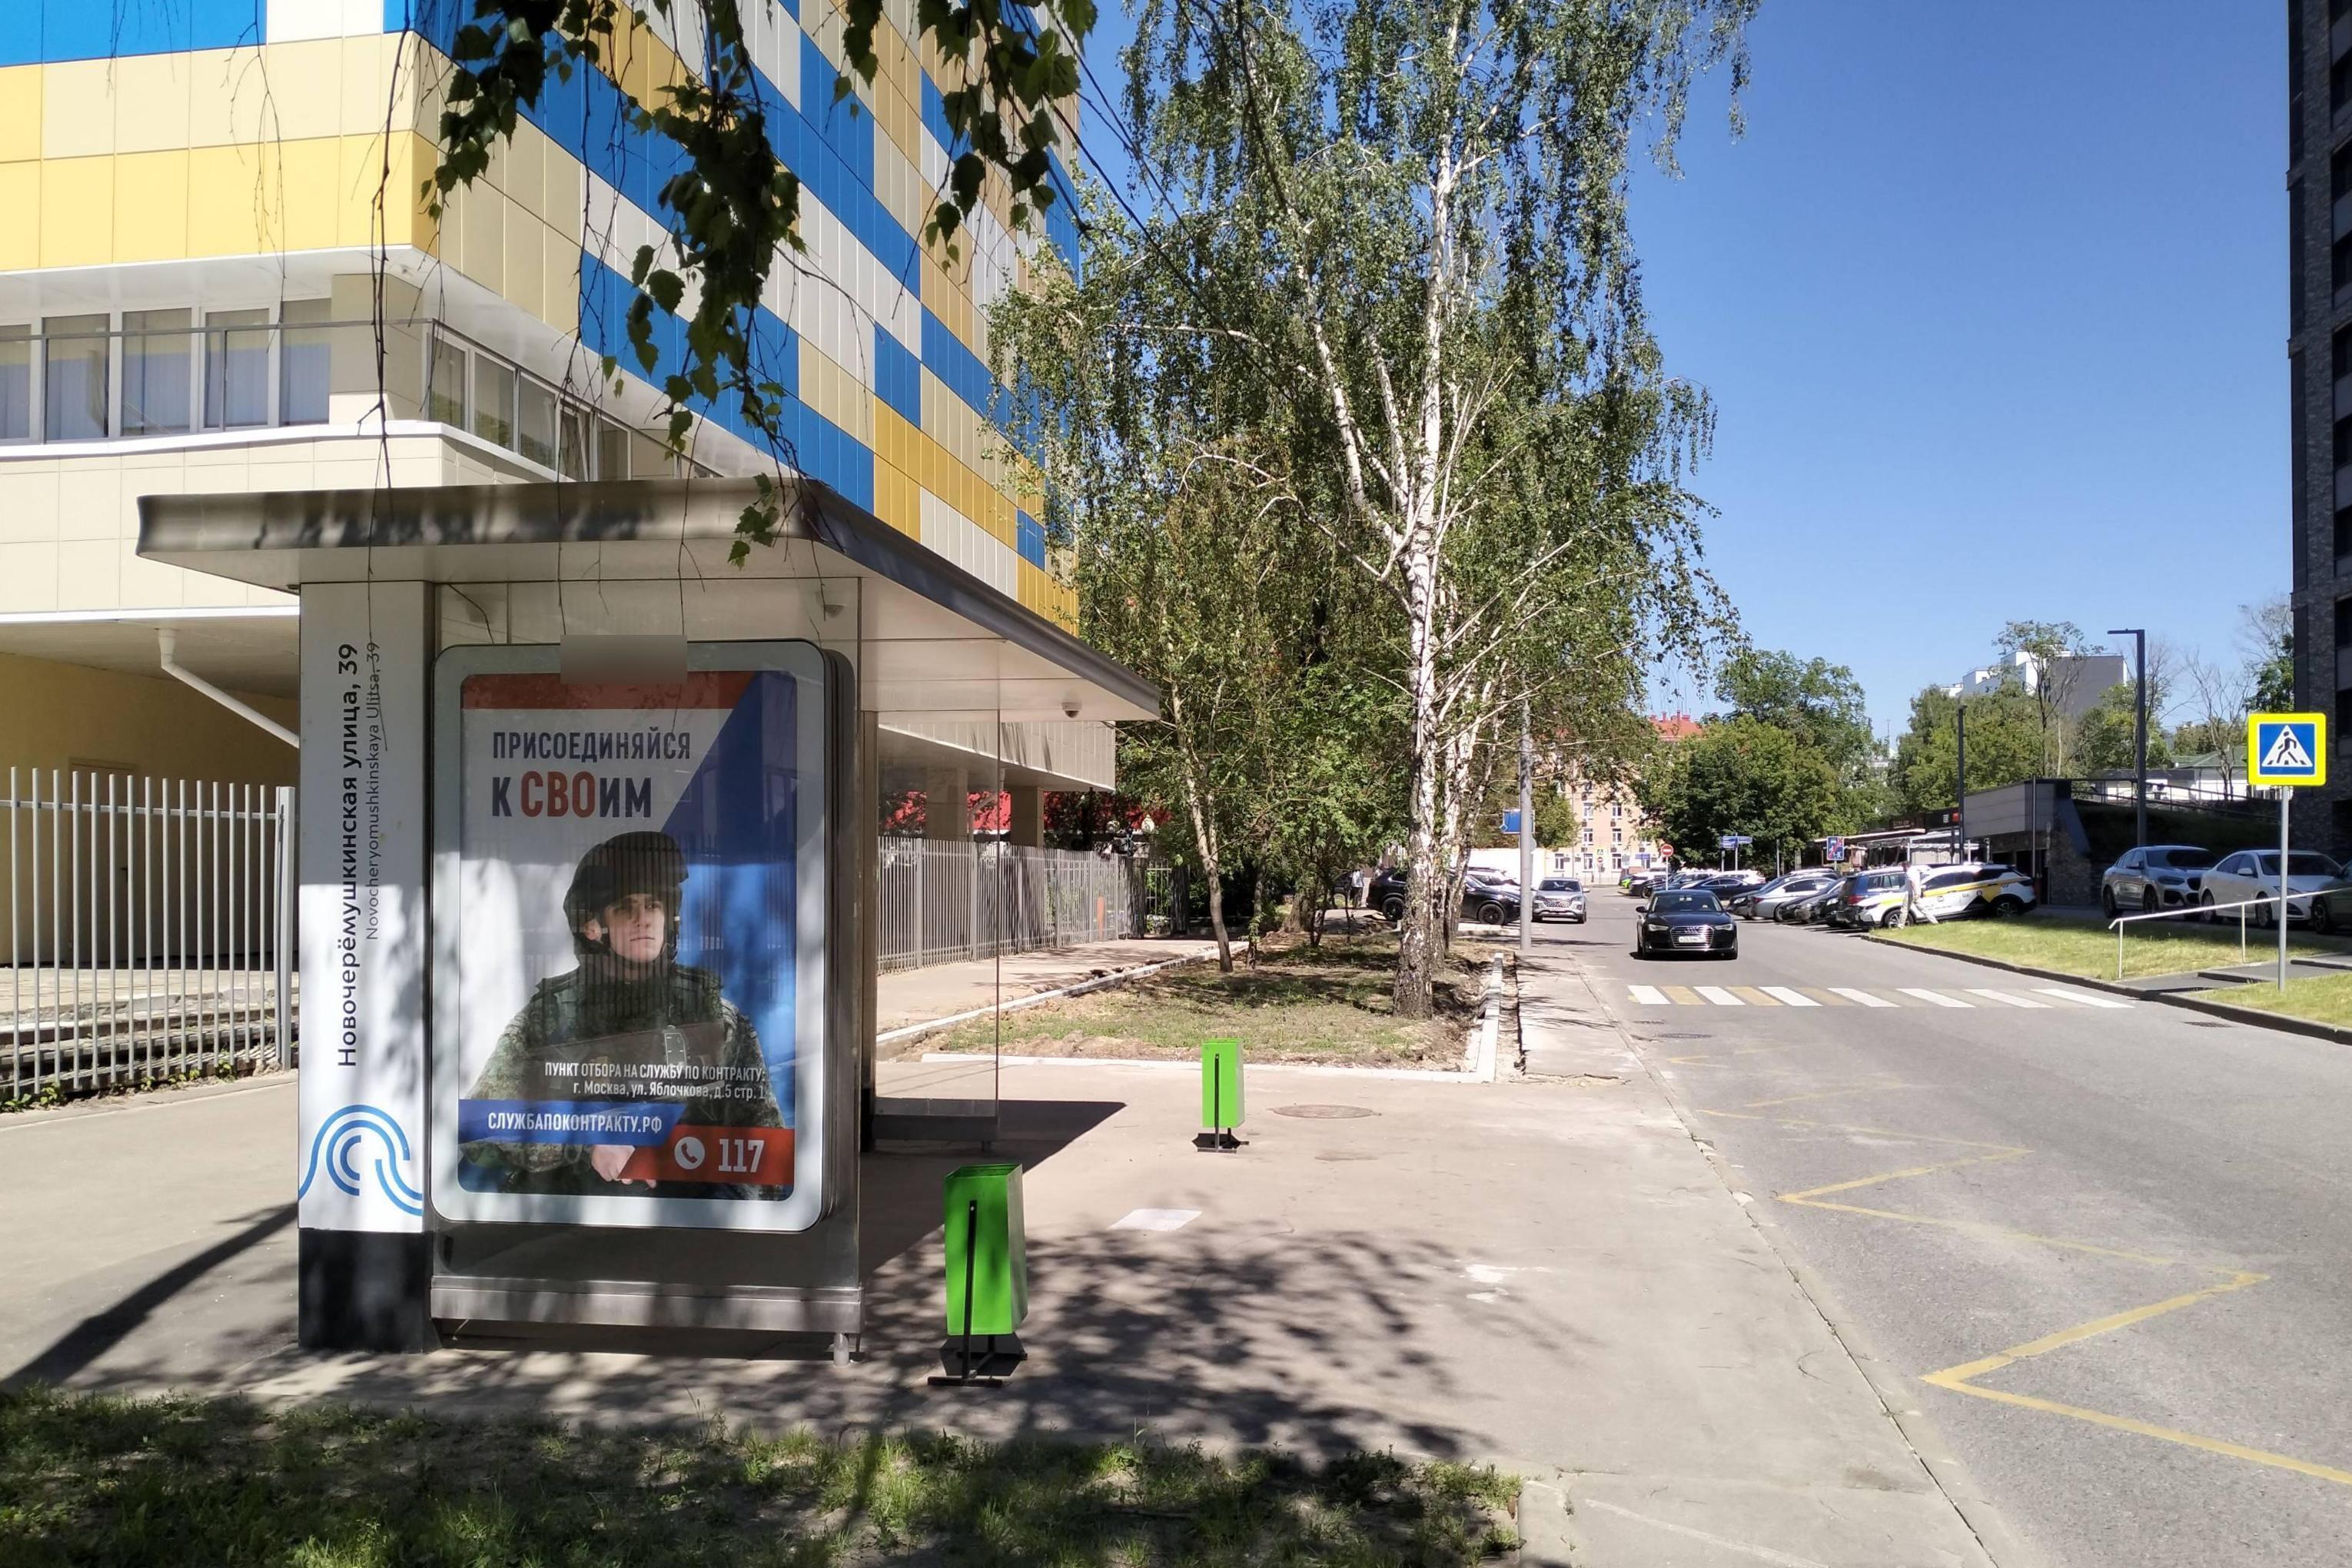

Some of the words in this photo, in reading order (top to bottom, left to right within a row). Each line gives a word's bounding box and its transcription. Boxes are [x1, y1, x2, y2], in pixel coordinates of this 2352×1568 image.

[338, 643, 357, 675] 39
[367, 642, 380, 663] 39
[366, 669, 381, 719] Ulitsa,
[343, 684, 362, 769] улица,
[493, 726, 690, 762] ПРИСОЕДИНЯЙСЯ
[492, 776, 512, 817] К
[521, 770, 652, 818] СВОИМ
[365, 725, 381, 940] Novocheryomushkinskaya
[338, 777, 360, 1067] Новочерёмушкинская
[545, 1062, 579, 1076] ПУНКТ
[581, 1063, 621, 1077] ОТБОРА
[624, 1064, 638, 1078] НА
[639, 1064, 684, 1079] СЛУЖБУ
[685, 1066, 699, 1080] ПО
[702, 1066, 766, 1082] КОНТРАКТУ:
[573, 1083, 581, 1094] г.
[584, 1081, 630, 1097] Москва,
[631, 1084, 647, 1098] ул.
[649, 1082, 713, 1099] Яблочкова,
[734, 1086, 756, 1101] стр.
[488, 1111, 662, 1134] СЛУЖБАПОКОНТРАКТУ.РФ
[718, 1138, 765, 1173] 117
